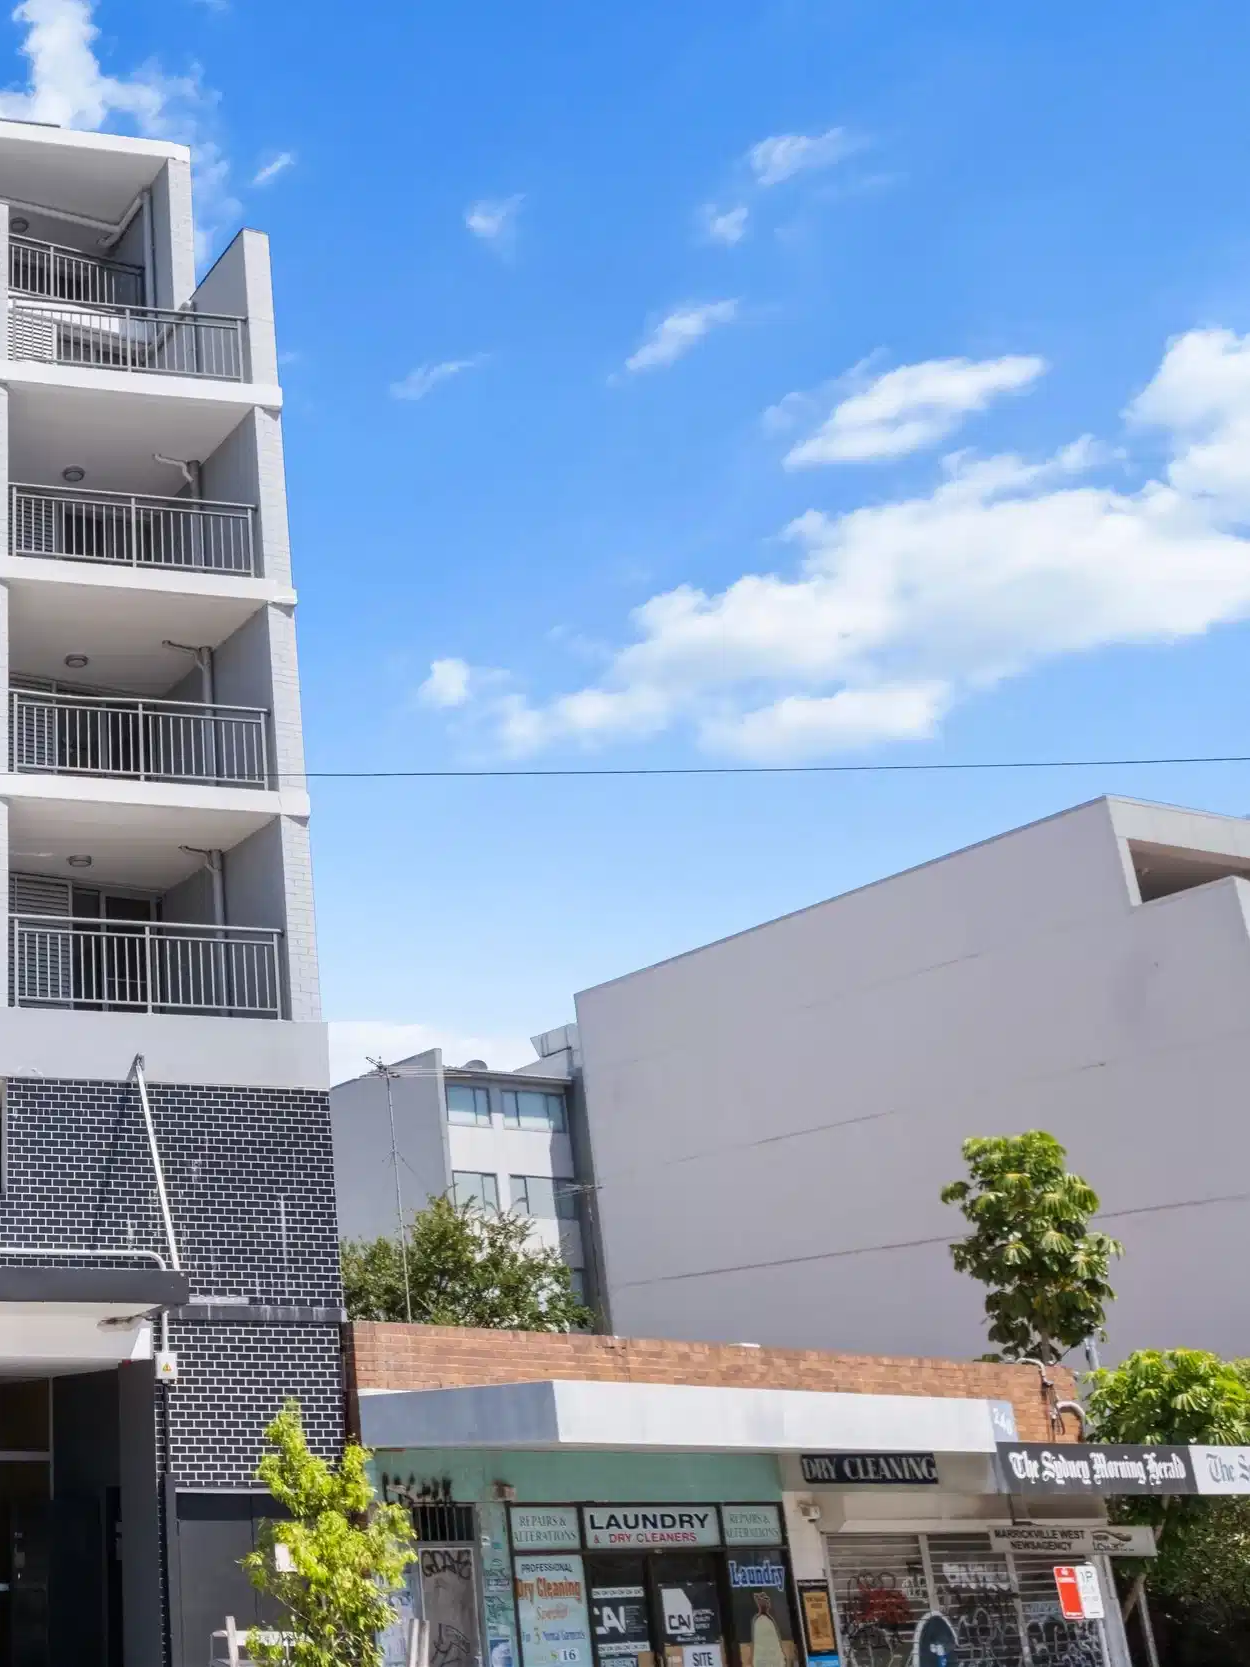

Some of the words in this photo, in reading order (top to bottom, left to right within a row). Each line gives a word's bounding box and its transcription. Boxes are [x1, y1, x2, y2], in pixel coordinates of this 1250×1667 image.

[802, 1458, 837, 1479] DRY
[842, 1456, 938, 1480] CLEANING
[1008, 1451, 1040, 1485] The
[1041, 1451, 1091, 1485] Sydney
[1090, 1451, 1146, 1485] Morning
[1144, 1452, 1187, 1485] Herald
[1206, 1452, 1235, 1483] The
[519, 1515, 558, 1527] REPAIRS
[589, 1513, 709, 1530] LAUNDRY
[593, 1533, 601, 1544] &
[609, 1533, 633, 1544] DRY
[636, 1532, 697, 1543] CLEANERS
[994, 1530, 1058, 1540] MARRICKVILLE
[1059, 1530, 1085, 1540] WEST
[1010, 1541, 1072, 1550] NEWSAGENCY
[521, 1563, 573, 1573] PROFESSIONAL
[728, 1560, 785, 1591] Laundry
[514, 1577, 534, 1604] Dry
[537, 1576, 582, 1603] Cleaning
[562, 1649, 577, 1661] 16
[692, 1652, 715, 1667] SITE
